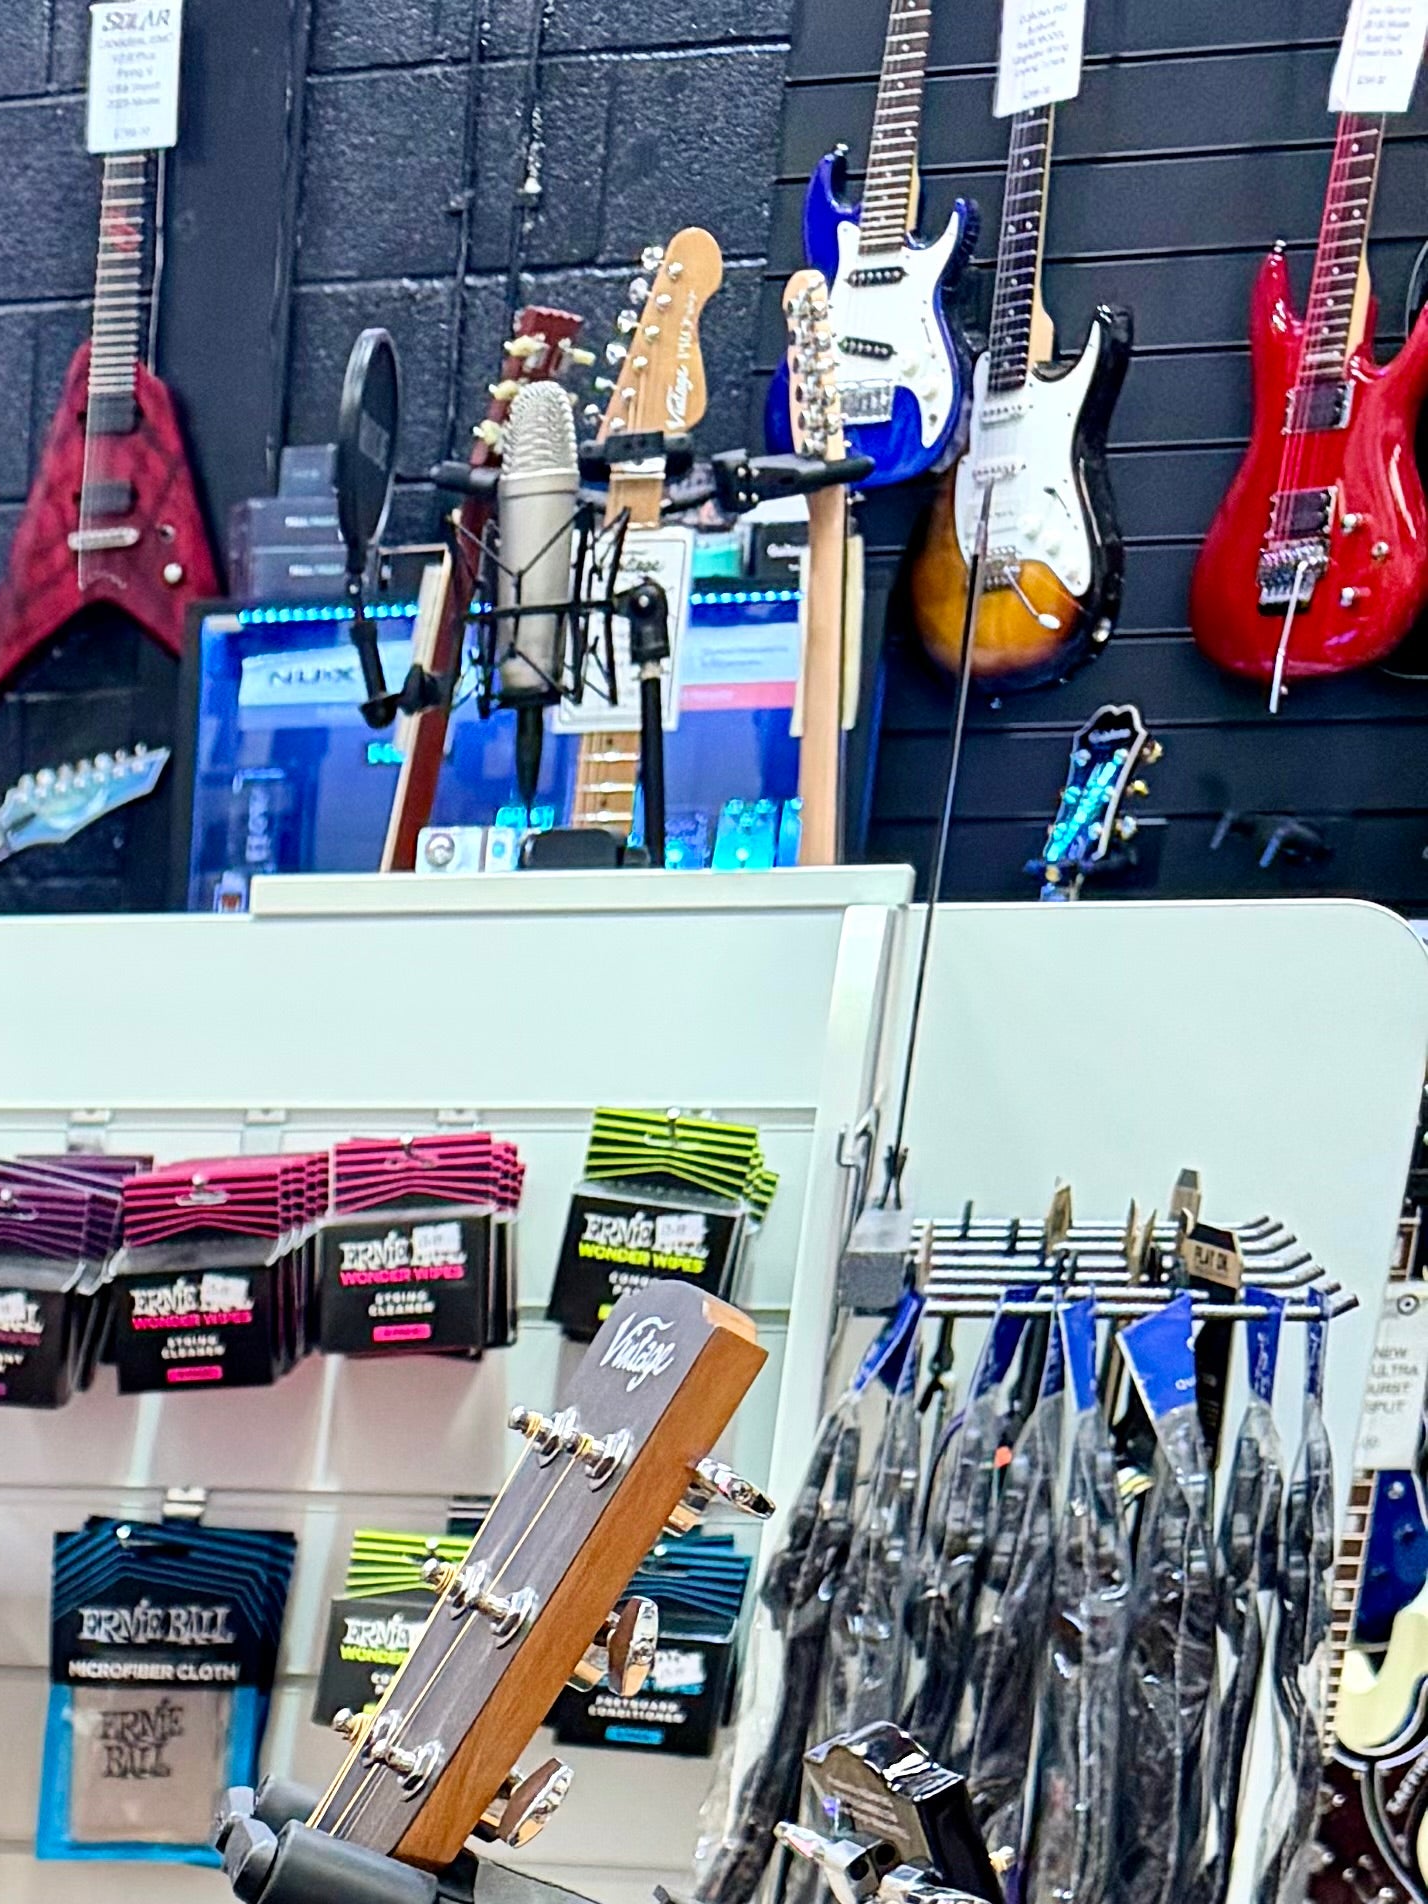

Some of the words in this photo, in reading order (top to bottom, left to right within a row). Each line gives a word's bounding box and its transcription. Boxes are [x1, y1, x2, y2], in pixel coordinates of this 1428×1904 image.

[339, 1229, 411, 1270] ERNIE
[581, 1210, 654, 1250] ERNIE
[339, 1269, 411, 1287] WONDER
[411, 1265, 466, 1283] WIPES
[579, 1241, 652, 1267] WONDER
[653, 1252, 706, 1274] WIPES
[129, 1277, 198, 1317] ERNIE
[131, 1312, 201, 1330] WONDER
[599, 1312, 675, 1393] Vintage
[77, 1597, 164, 1644] ERNIE
[164, 1606, 237, 1646] BALL
[68, 1660, 175, 1681] MICROFIBER
[176, 1662, 241, 1682] CLOTH
[99, 1697, 185, 1746] ERNIE
[102, 1744, 172, 1780] BALL
